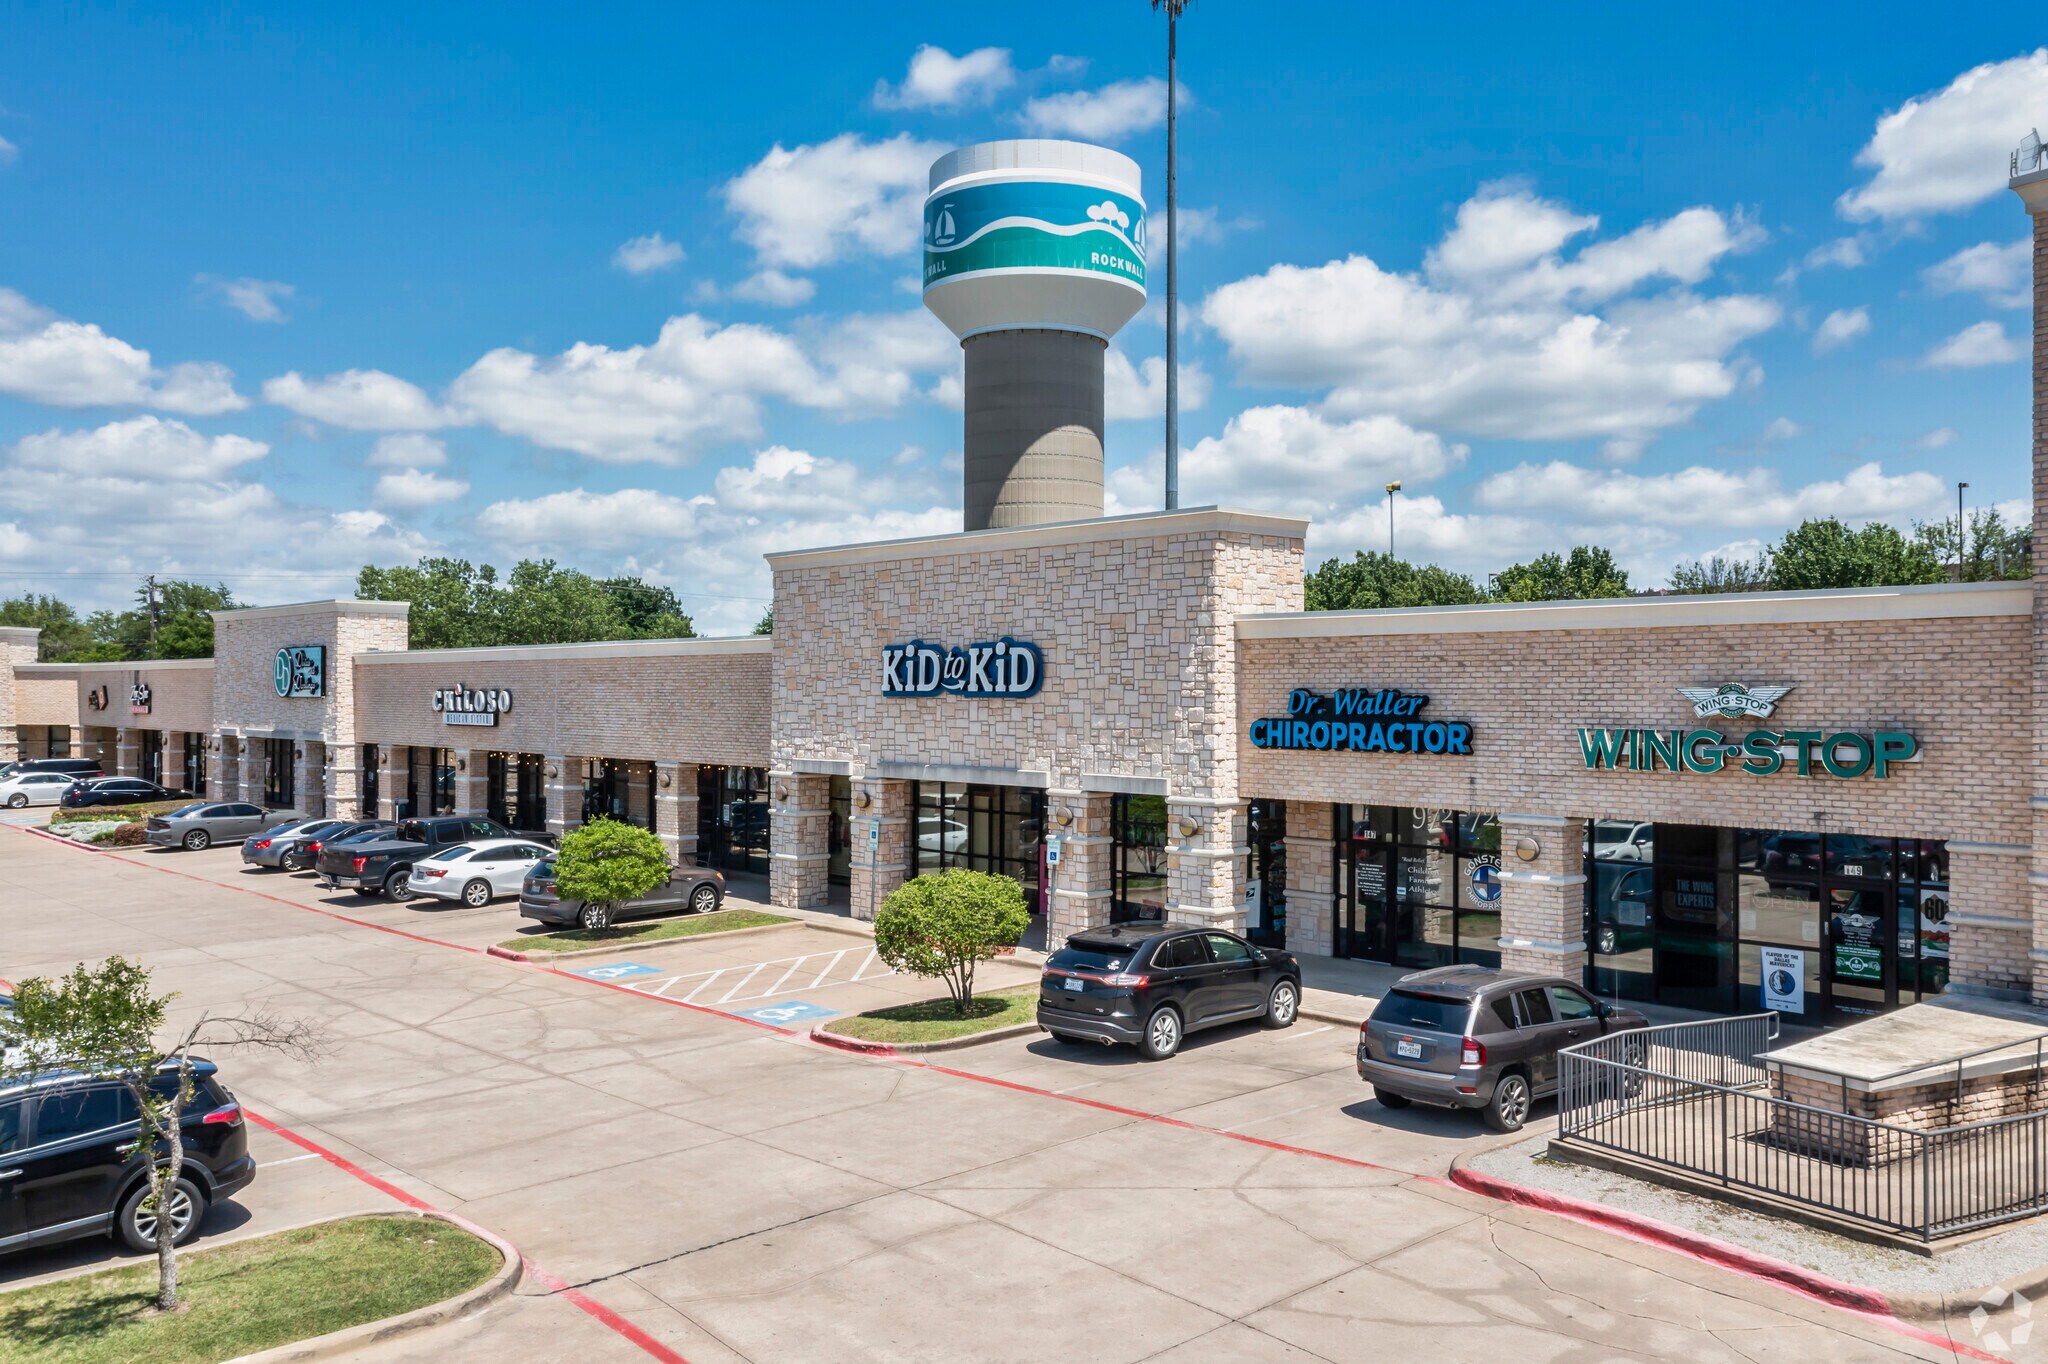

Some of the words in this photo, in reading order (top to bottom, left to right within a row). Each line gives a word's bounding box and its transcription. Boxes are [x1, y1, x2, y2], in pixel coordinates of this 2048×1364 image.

[1091, 251, 1143, 280] ROCKWALL
[943, 651, 965, 679] to
[1287, 689, 1326, 715] Dr.
[1333, 689, 1423, 715] Waller
[1250, 719, 1467, 753] CHIROPRACTOR
[1676, 879, 1690, 892] THE
[1692, 880, 1715, 894] WING
[1677, 894, 1715, 909] EXPERTS
[1752, 889, 1809, 910] OPEN
[1769, 961, 1796, 969] MAVERICKS
